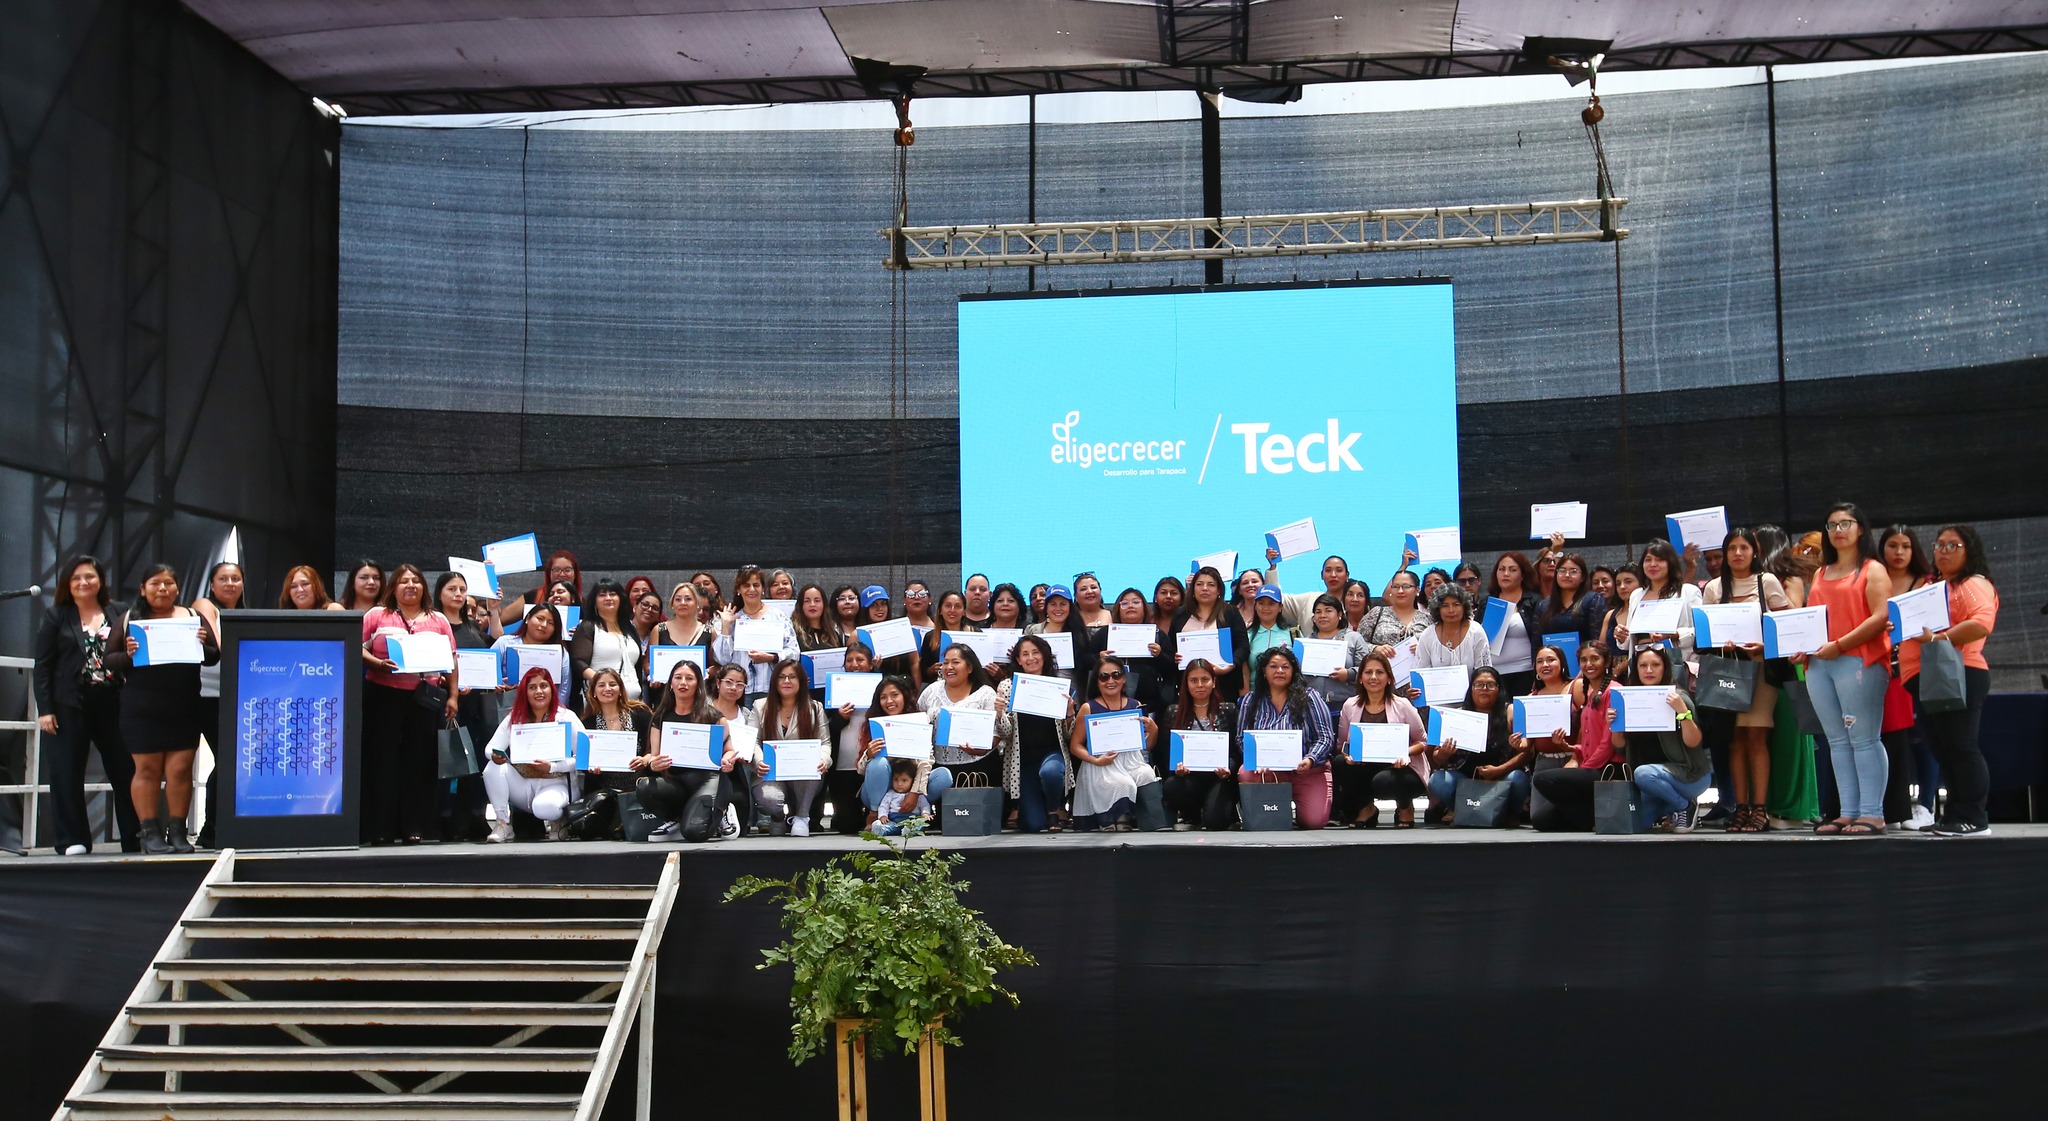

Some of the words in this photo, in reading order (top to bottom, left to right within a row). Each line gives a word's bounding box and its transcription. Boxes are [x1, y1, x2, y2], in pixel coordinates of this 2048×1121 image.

[1051, 427, 1186, 468] eligecrecer
[1231, 417, 1364, 474] Teck
[1103, 468, 1138, 477] Desarrollo
[1139, 469, 1154, 477] para
[1156, 467, 1187, 476] Tarapacá
[299, 662, 333, 676] Teck
[1718, 679, 1736, 689] Teck
[1466, 798, 1481, 806] Teck
